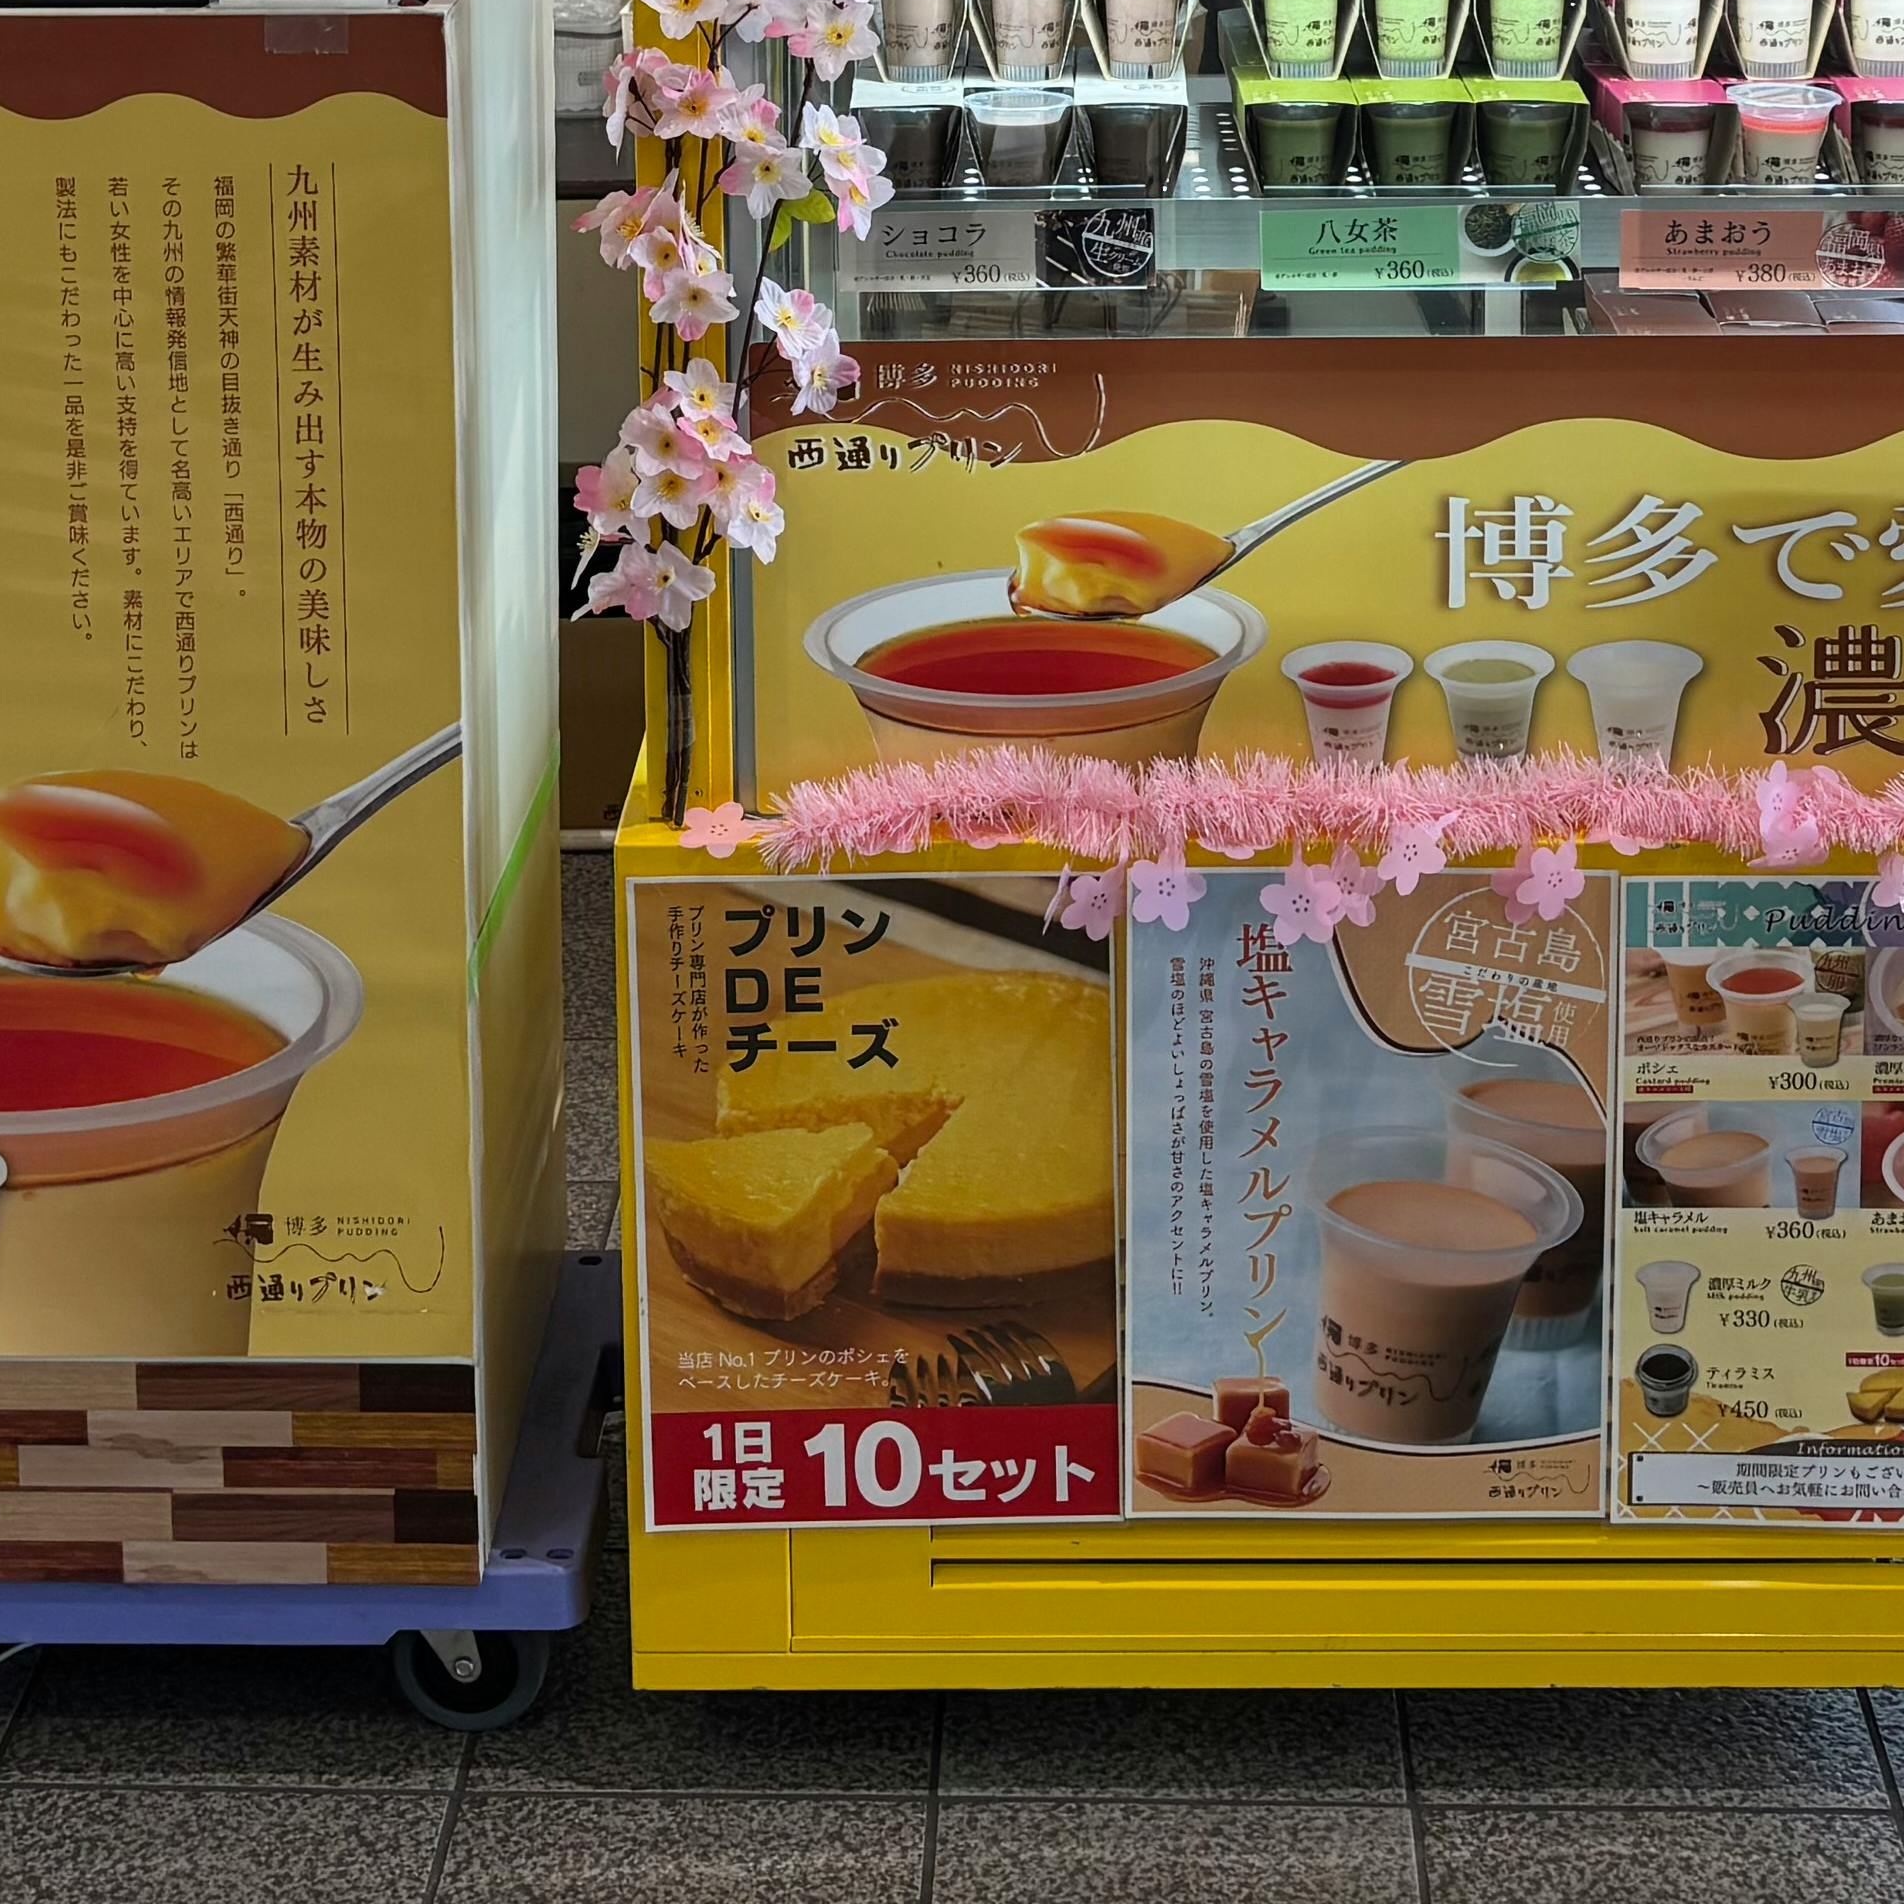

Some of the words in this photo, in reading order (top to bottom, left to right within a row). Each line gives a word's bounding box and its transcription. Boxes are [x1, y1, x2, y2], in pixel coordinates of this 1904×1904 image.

[879, 221, 988, 248] ショコラ
[1315, 217, 1400, 245] 八女茶
[1663, 217, 1773, 248] あまおう
[875, 362, 939, 391] 博多
[55, 176, 94, 643] 製法にもこだわった一品を是非ご賞味ください。
[286, 163, 332, 726] 九州素材が生み出す本物の美味しさ
[786, 431, 1024, 474] 西通りプリン
[724, 904, 893, 958] プリン
[1441, 907, 1584, 975] 宮古島
[666, 905, 688, 1058] 手作りチーズケーキ
[688, 904, 709, 1074] プリン専門店が作った
[724, 965, 826, 1015] DE
[1417, 972, 1553, 1047] 雪塩
[725, 1017, 900, 1073] チーズ
[1233, 920, 1294, 1348] 塩キャラメルプリン
[283, 1213, 328, 1238] 博多
[225, 1272, 388, 1305] 西通りプリン
[677, 1349, 714, 1372] 当店
[717, 1348, 756, 1370] No.1
[763, 1343, 910, 1369] プリンのポシェを
[678, 1367, 897, 1392] ベースしたチーズケーキ。
[702, 1420, 774, 1466] 1日
[802, 1419, 1096, 1509] 10セット
[693, 1466, 786, 1512] 限定
